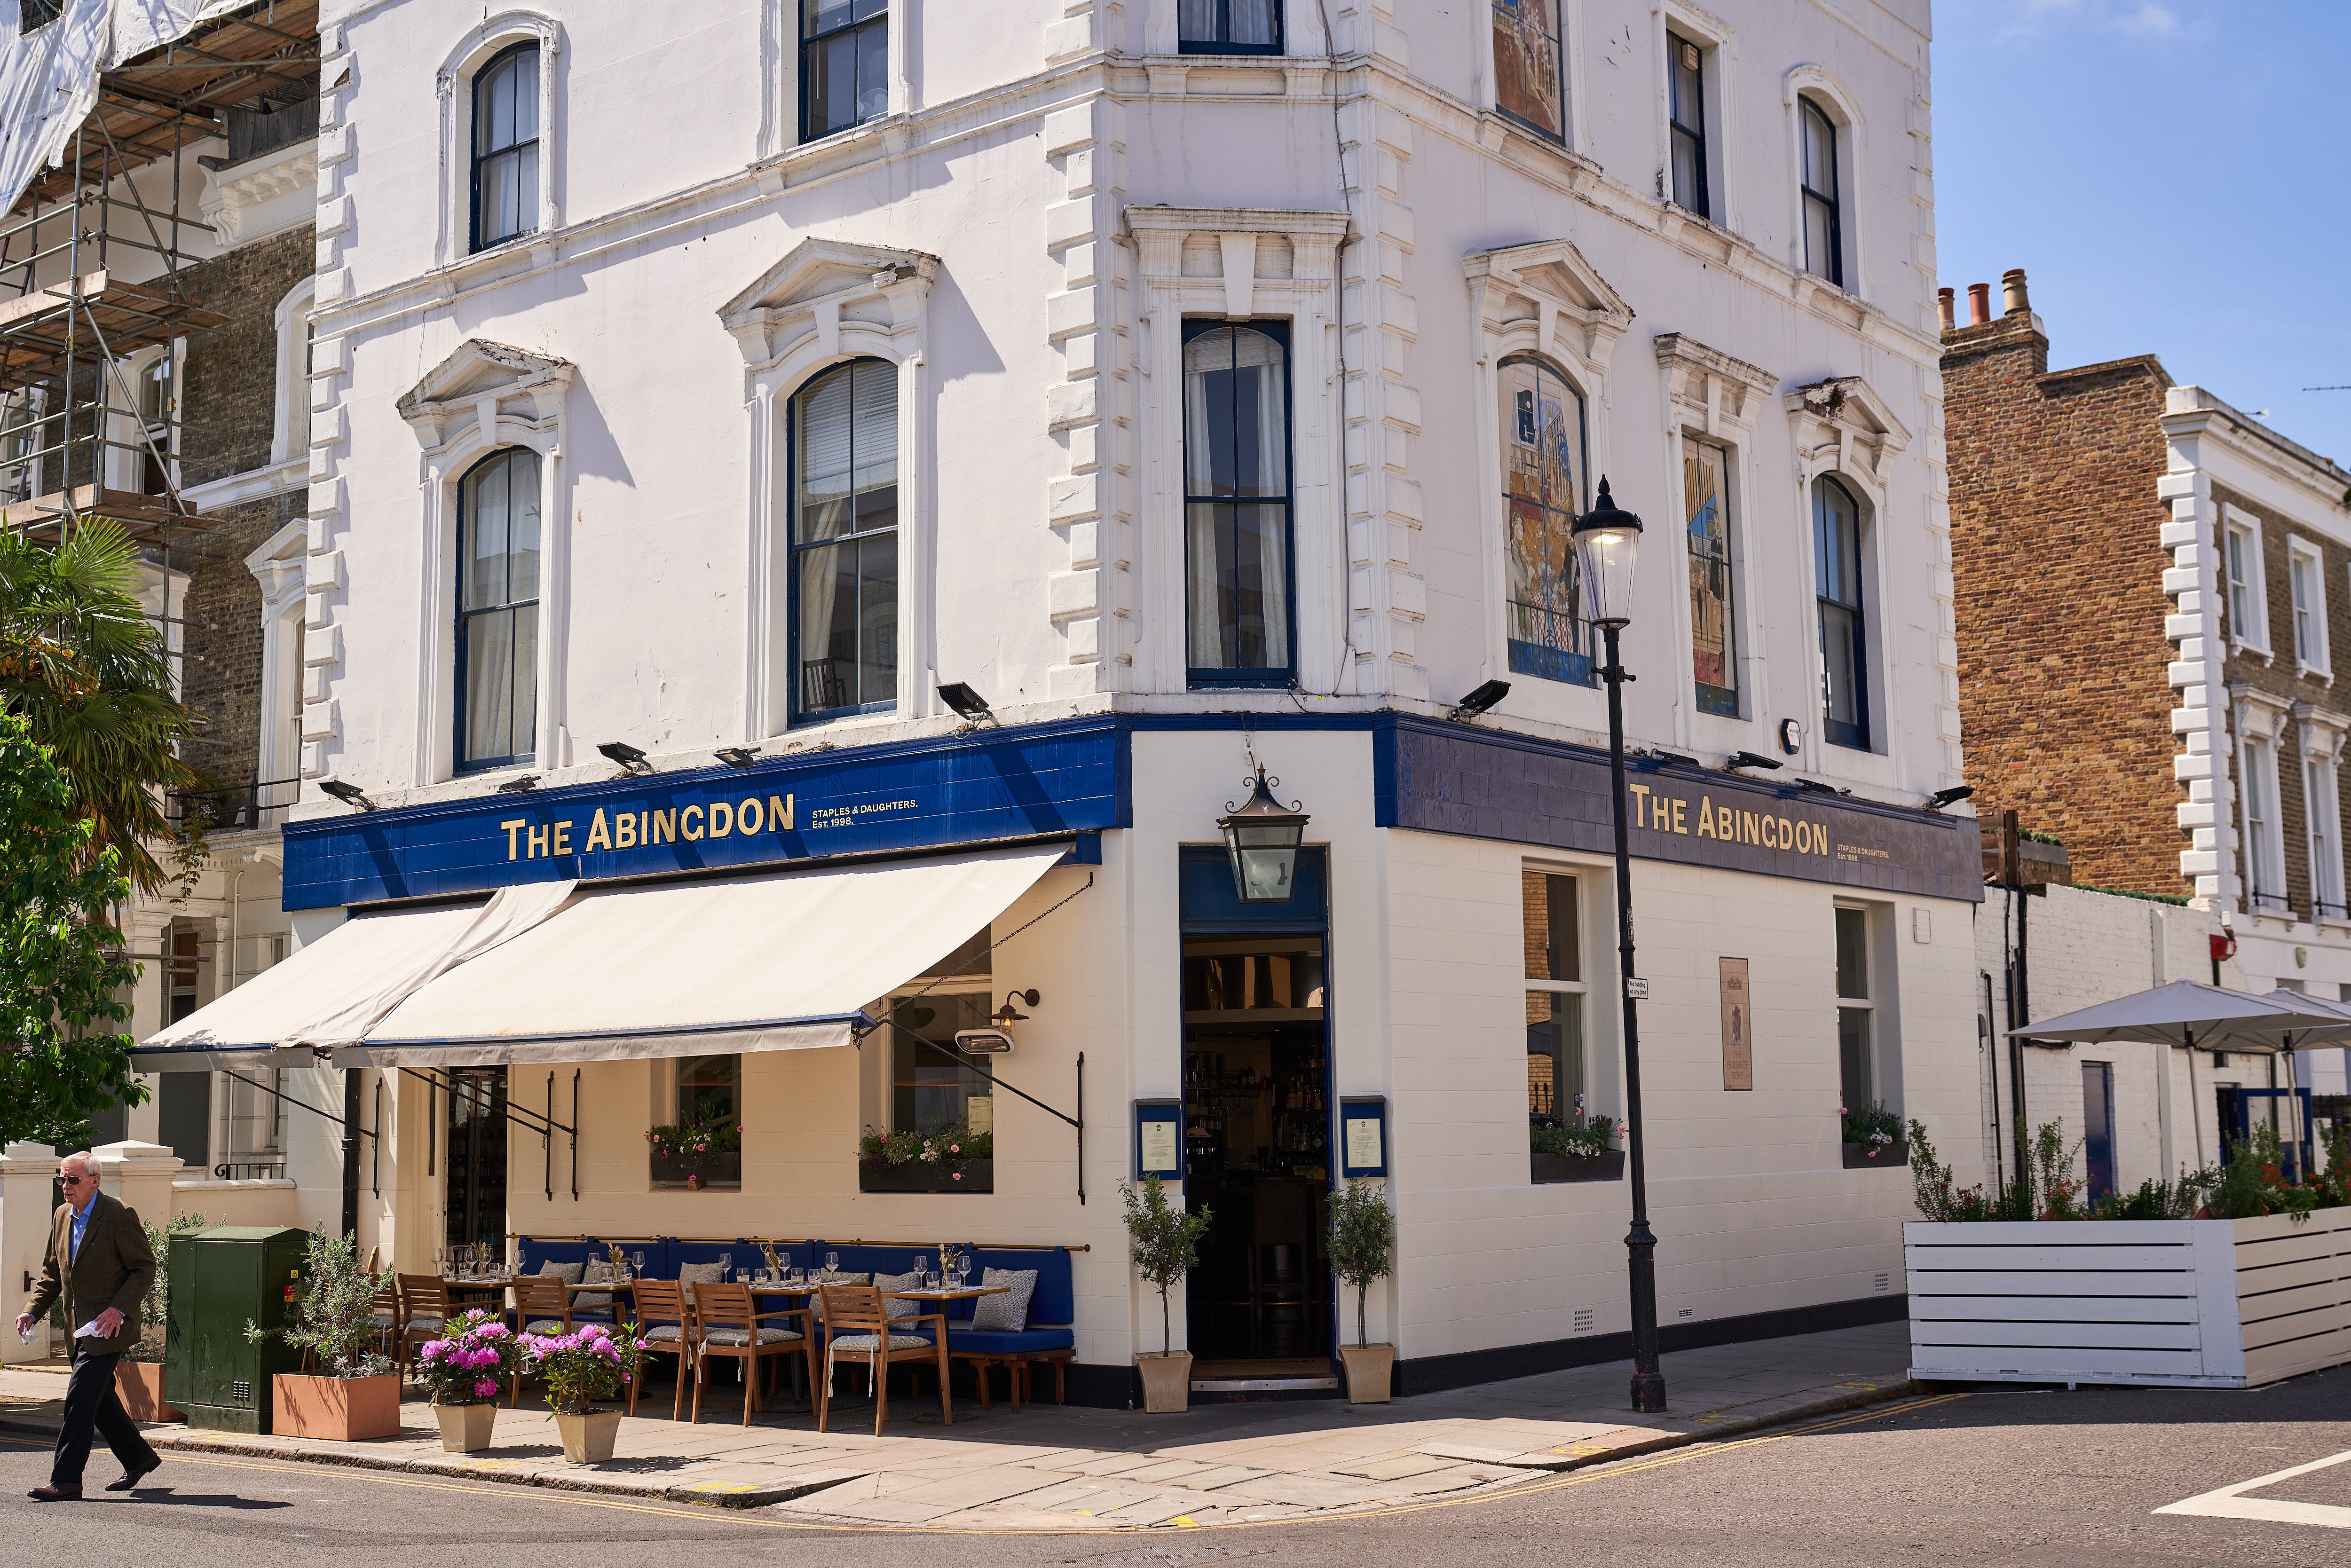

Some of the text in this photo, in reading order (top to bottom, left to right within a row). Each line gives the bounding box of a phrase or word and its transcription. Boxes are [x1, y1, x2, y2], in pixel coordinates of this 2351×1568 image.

[812, 799, 918, 819] STAPLES & DAUGHTERS.
[500, 793, 795, 860] THE ABINGDON
[813, 817, 853, 829] EST. 1998.
[1630, 783, 1828, 856] THE ABINGDON
[1837, 844, 1857, 853] STAPLES
[1862, 848, 1889, 859] DAUGHTERS.
[1727, 1061, 1748, 1069] HOUSE OF
[1731, 1071, 1744, 1079] TOBY
